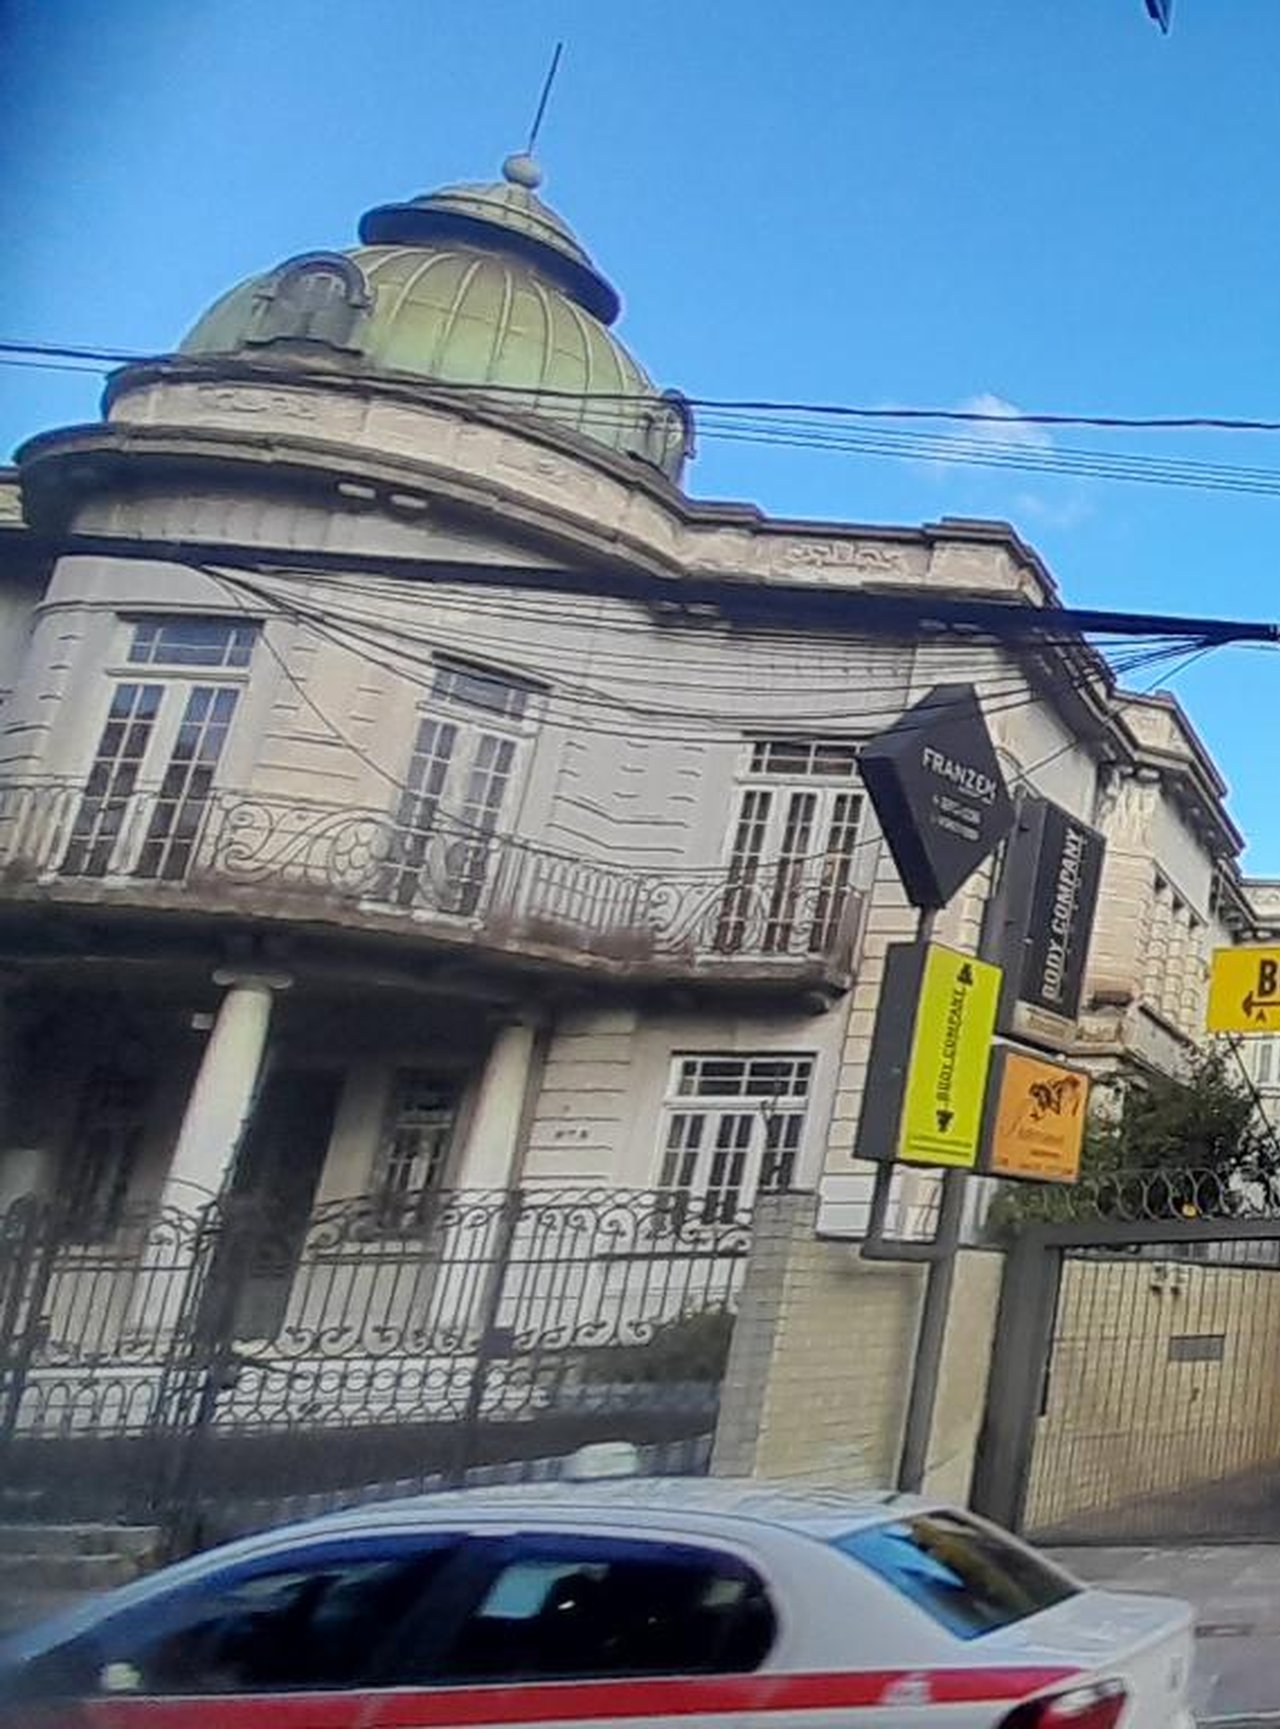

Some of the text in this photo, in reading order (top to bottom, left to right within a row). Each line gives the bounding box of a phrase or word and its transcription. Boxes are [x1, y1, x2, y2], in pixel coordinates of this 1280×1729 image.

[922, 747, 997, 801] FRANZEN
[1041, 827, 1084, 1001] BODY COMPANY
